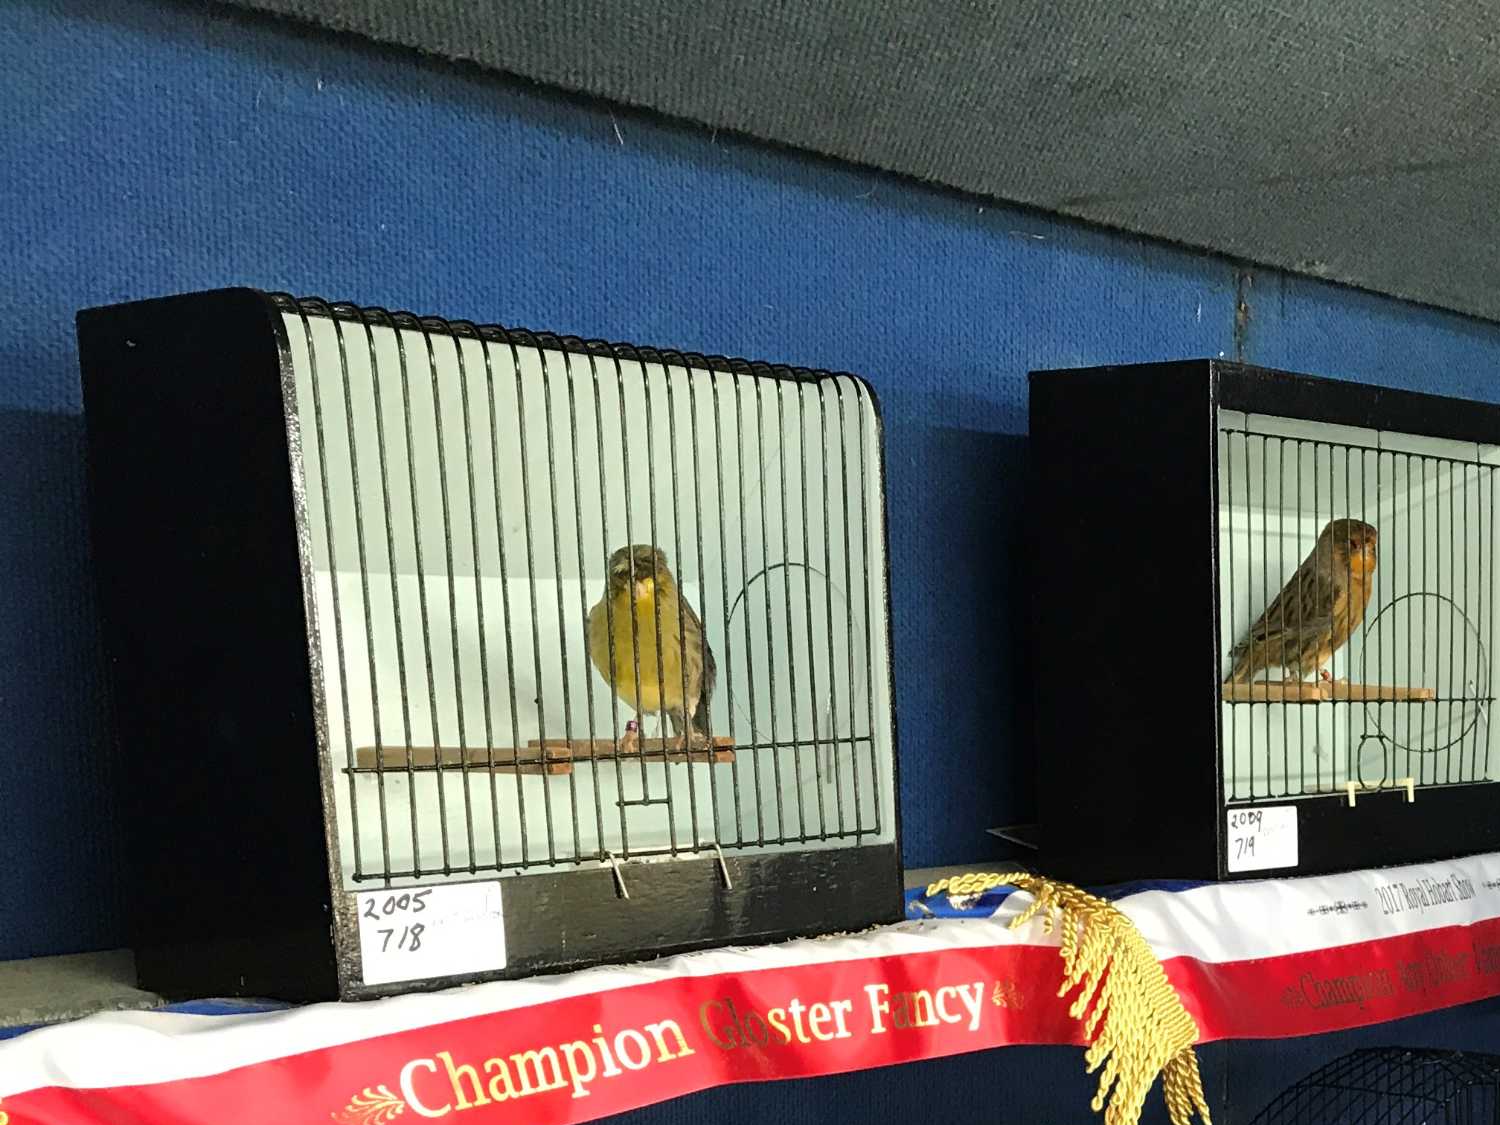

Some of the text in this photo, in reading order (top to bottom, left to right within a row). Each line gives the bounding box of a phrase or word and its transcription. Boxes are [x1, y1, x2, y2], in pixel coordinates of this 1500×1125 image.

[1231, 810, 1263, 833] 2009
[1235, 836, 1255, 860] 719
[364, 889, 433, 921] 2005
[1374, 874, 1476, 915] 2017 Royal Hobart Show
[377, 922, 425, 952] 718
[400, 982, 986, 1118] Champion Gloster Fancy
